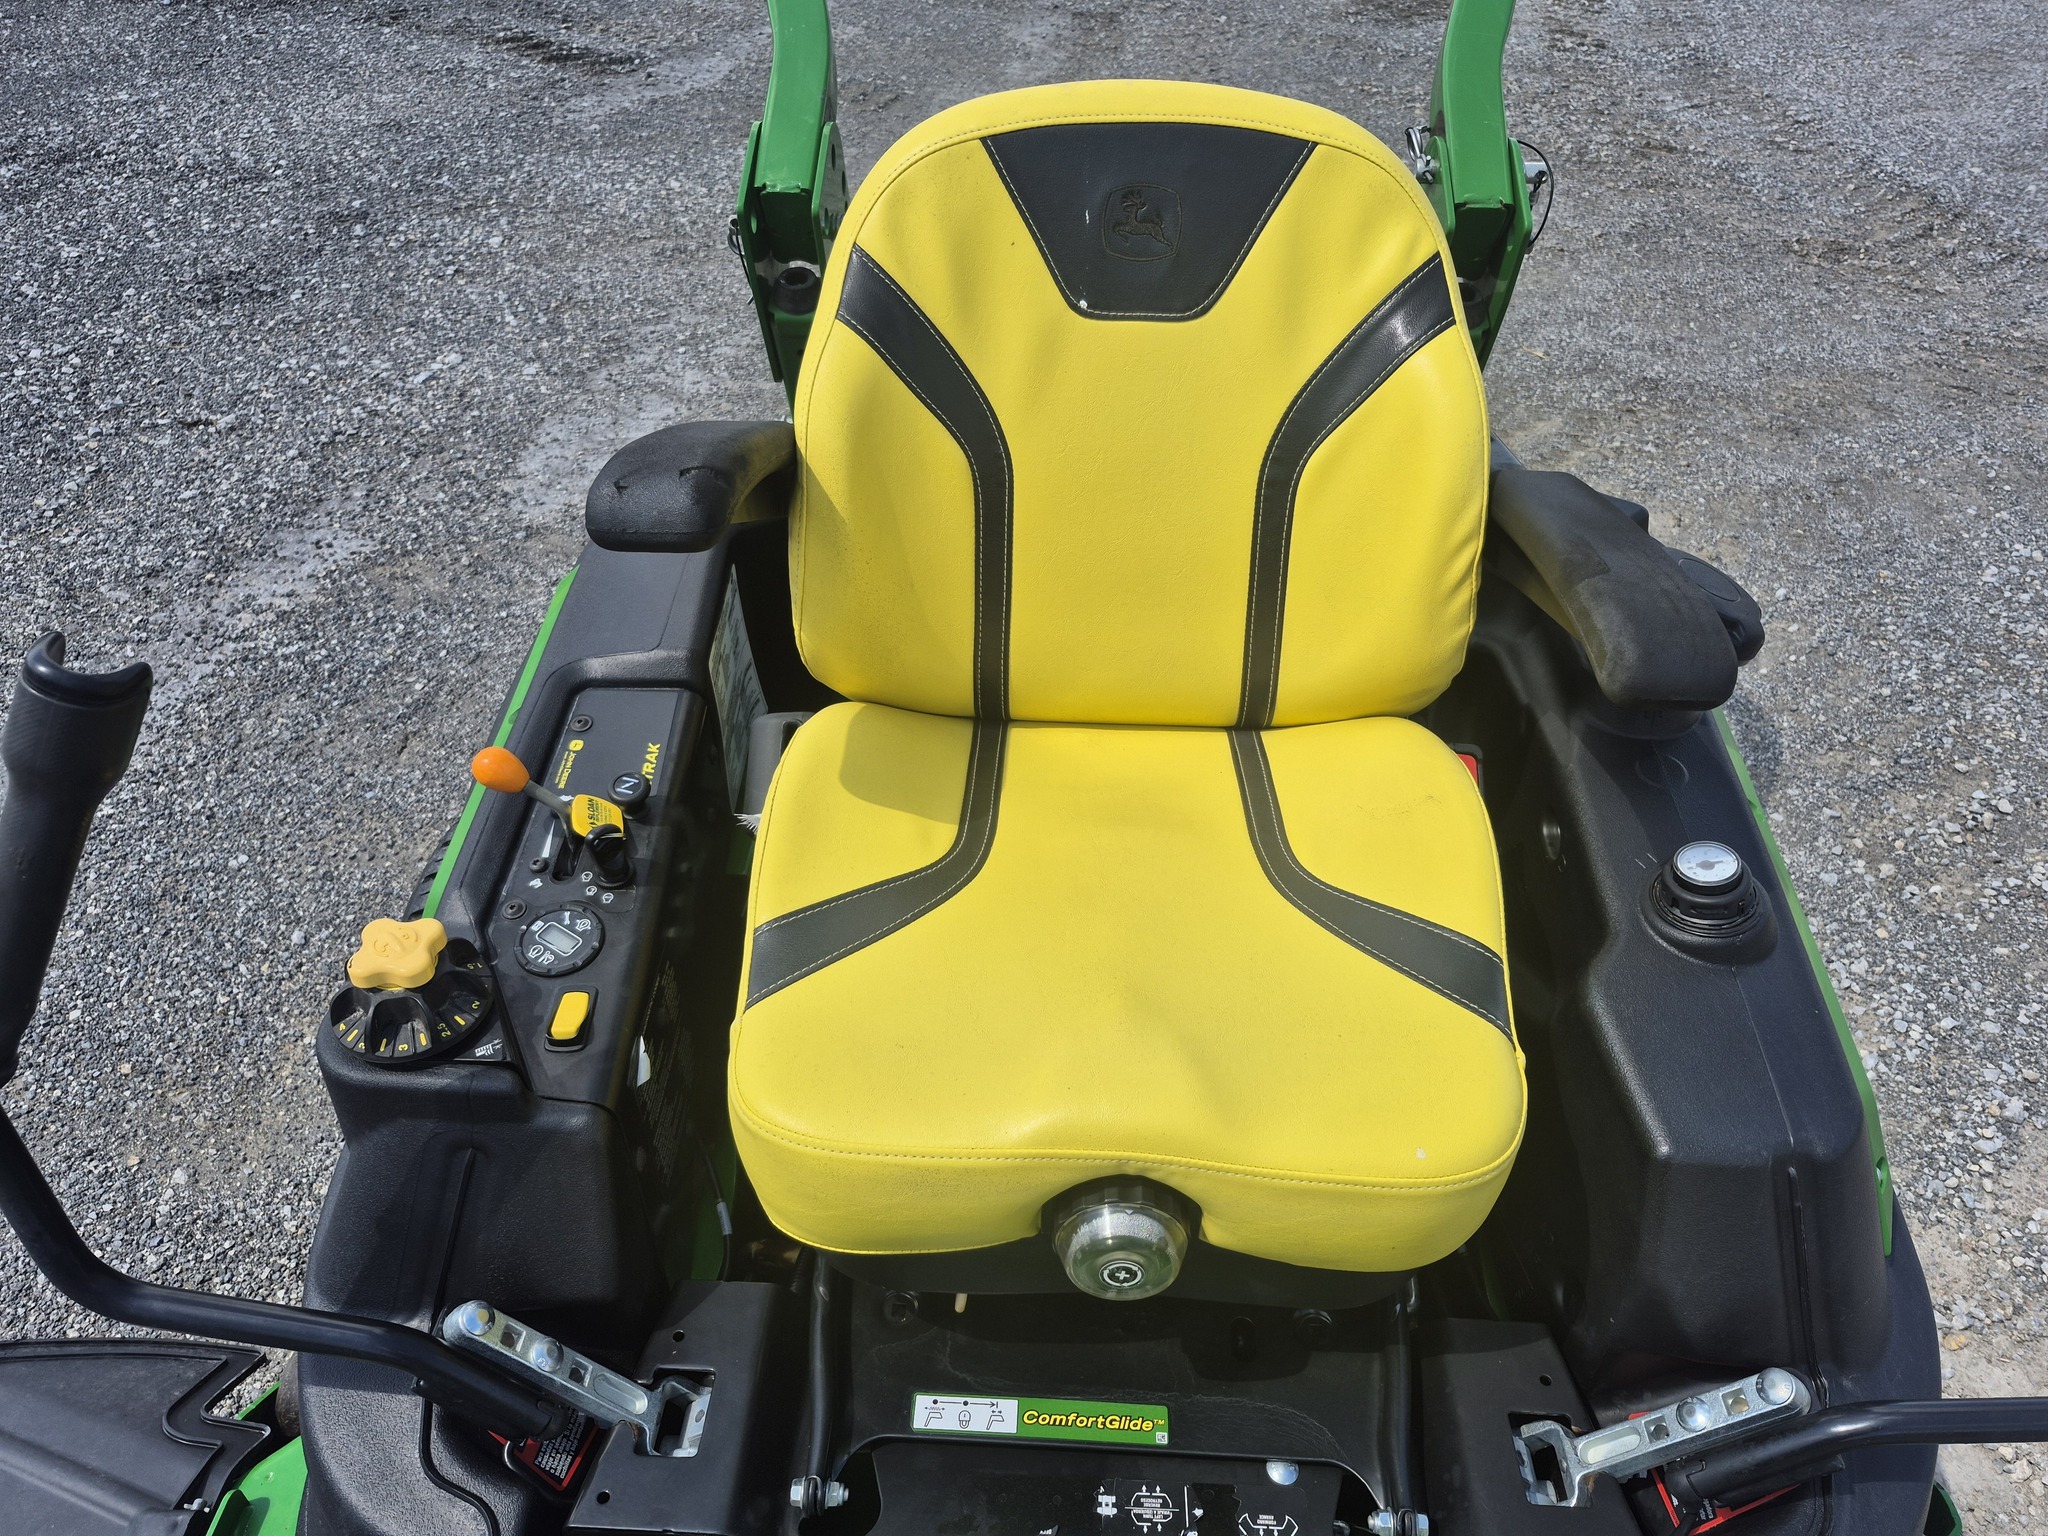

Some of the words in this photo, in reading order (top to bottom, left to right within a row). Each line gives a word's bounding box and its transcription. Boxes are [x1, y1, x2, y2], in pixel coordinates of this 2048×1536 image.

[641, 742, 661, 786] TRAK
[616, 776, 640, 795] N
[587, 797, 597, 821] SLOAN
[471, 1000, 481, 1010] 2
[437, 1023, 452, 1038] 2.5
[398, 1043, 409, 1052] 3
